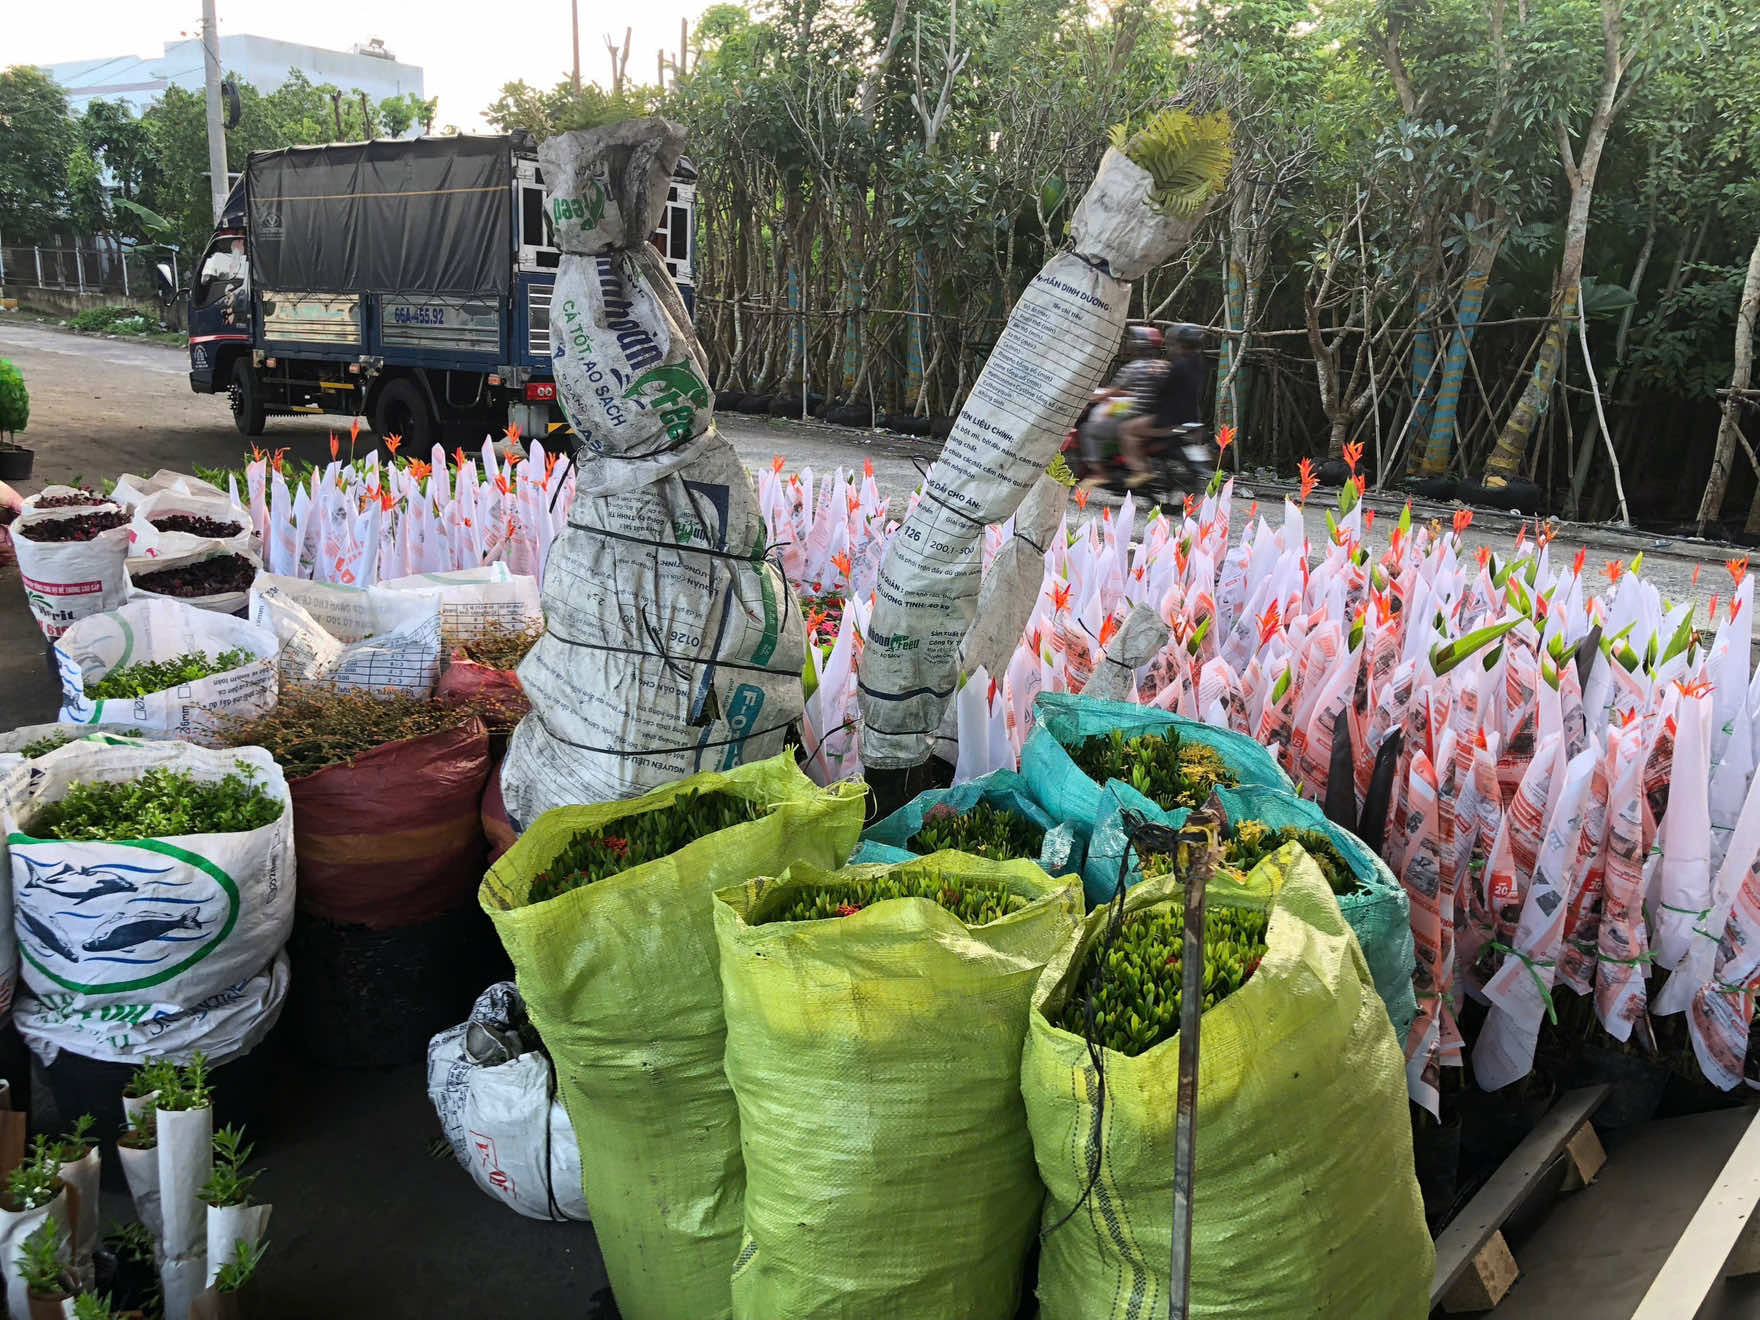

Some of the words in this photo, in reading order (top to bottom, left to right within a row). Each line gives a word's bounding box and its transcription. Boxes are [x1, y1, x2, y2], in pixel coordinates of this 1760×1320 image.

[562, 299, 577, 324] CÁ
[583, 360, 604, 383] AO
[595, 384, 627, 427] SẠCH
[947, 490, 965, 502] CHO
